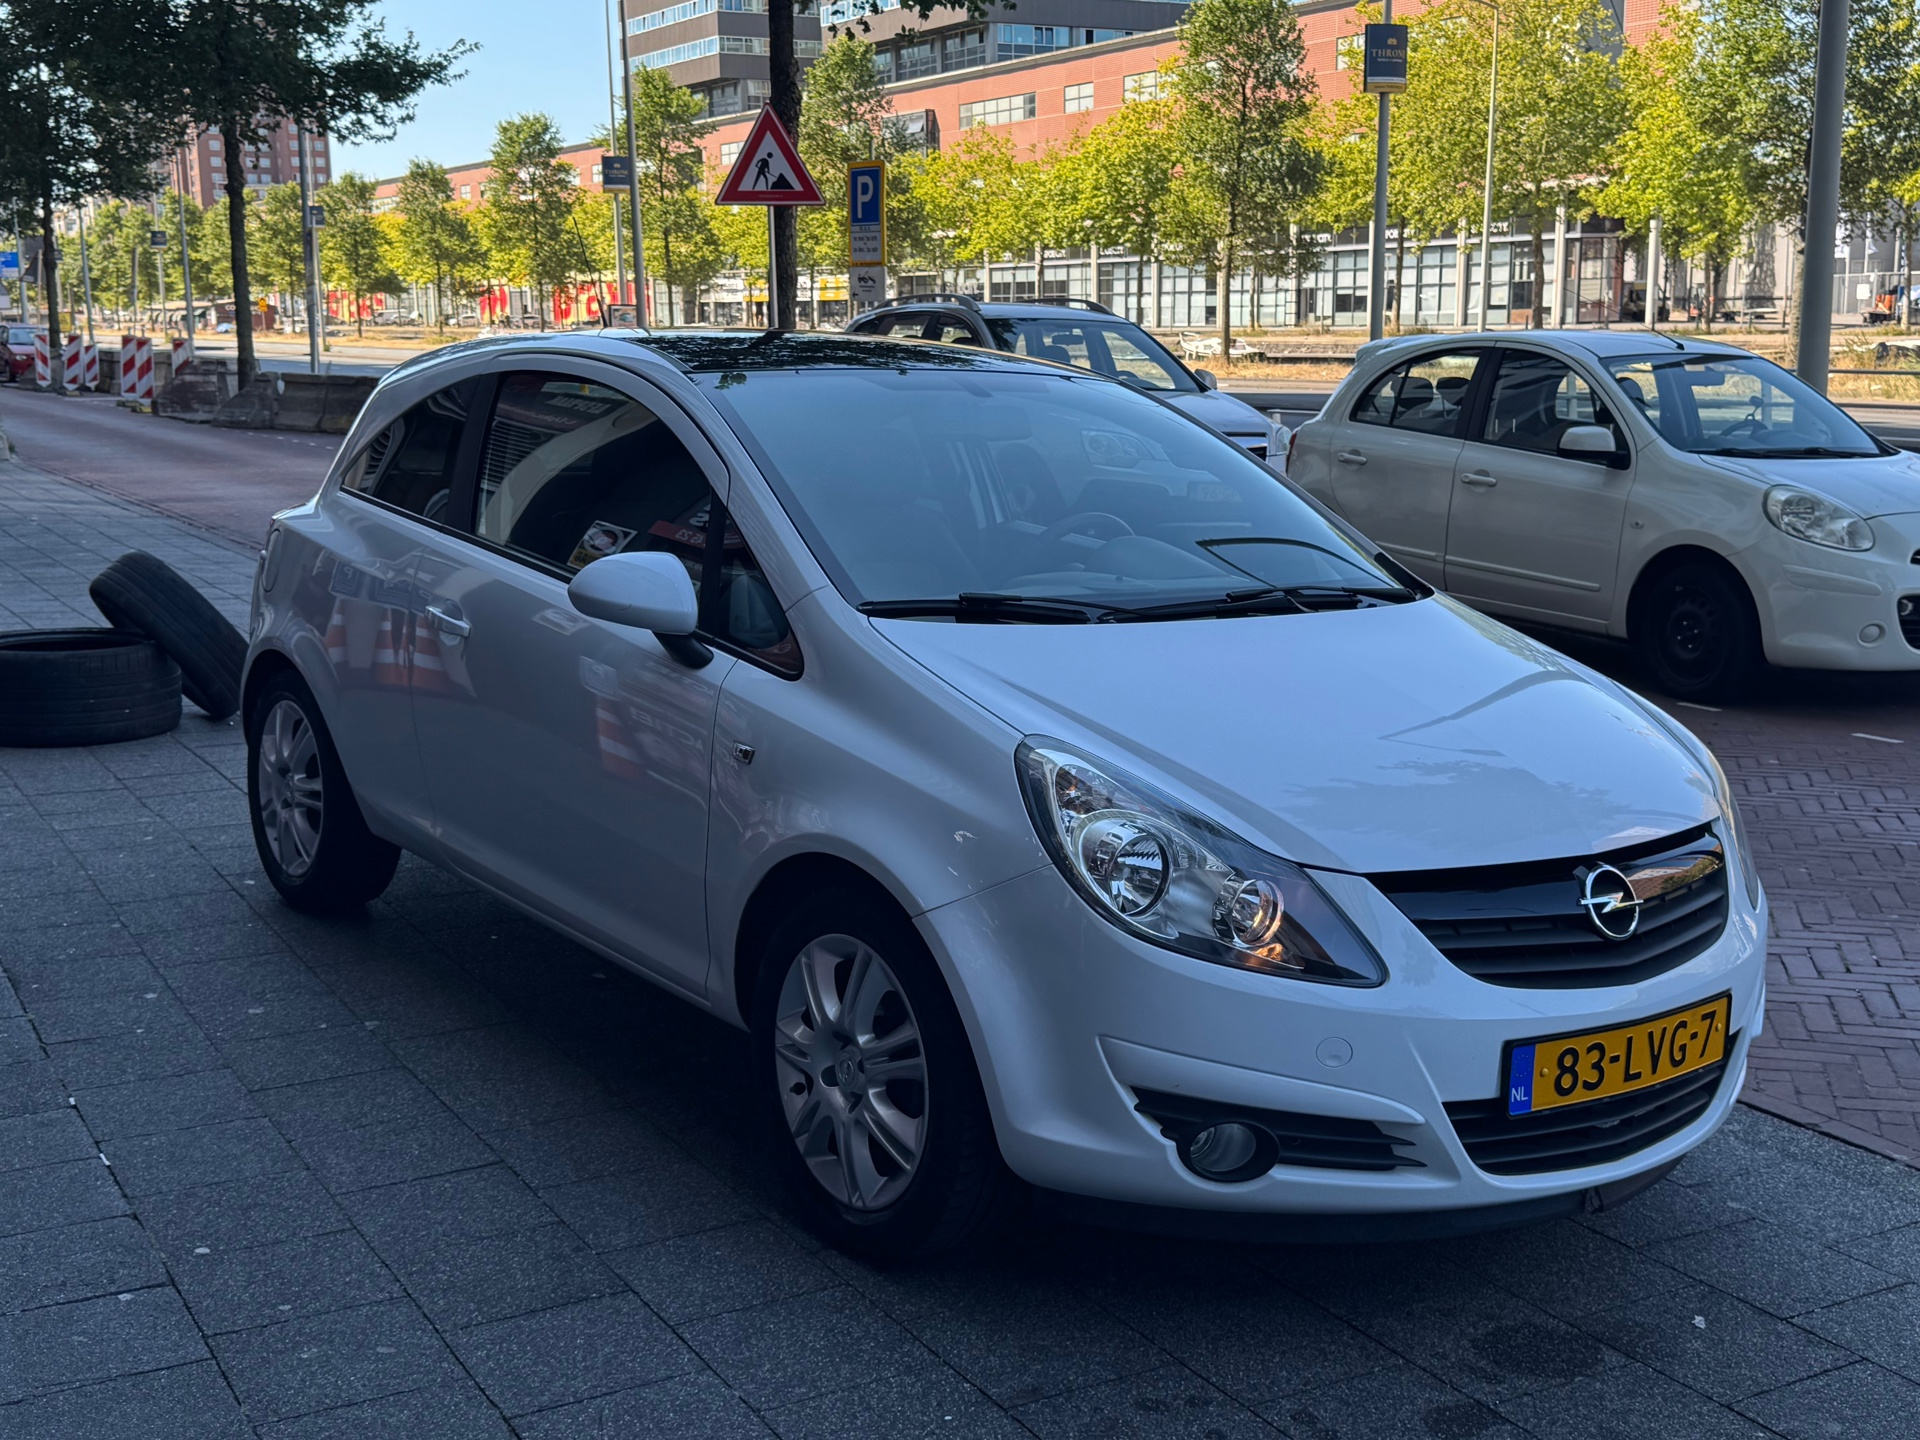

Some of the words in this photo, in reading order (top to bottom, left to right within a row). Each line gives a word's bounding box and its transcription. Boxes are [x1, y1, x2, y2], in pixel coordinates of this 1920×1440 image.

[857, 175, 874, 219] P
[1554, 1010, 1717, 1097] 83-LVG-7
[1511, 1086, 1528, 1103] NL
